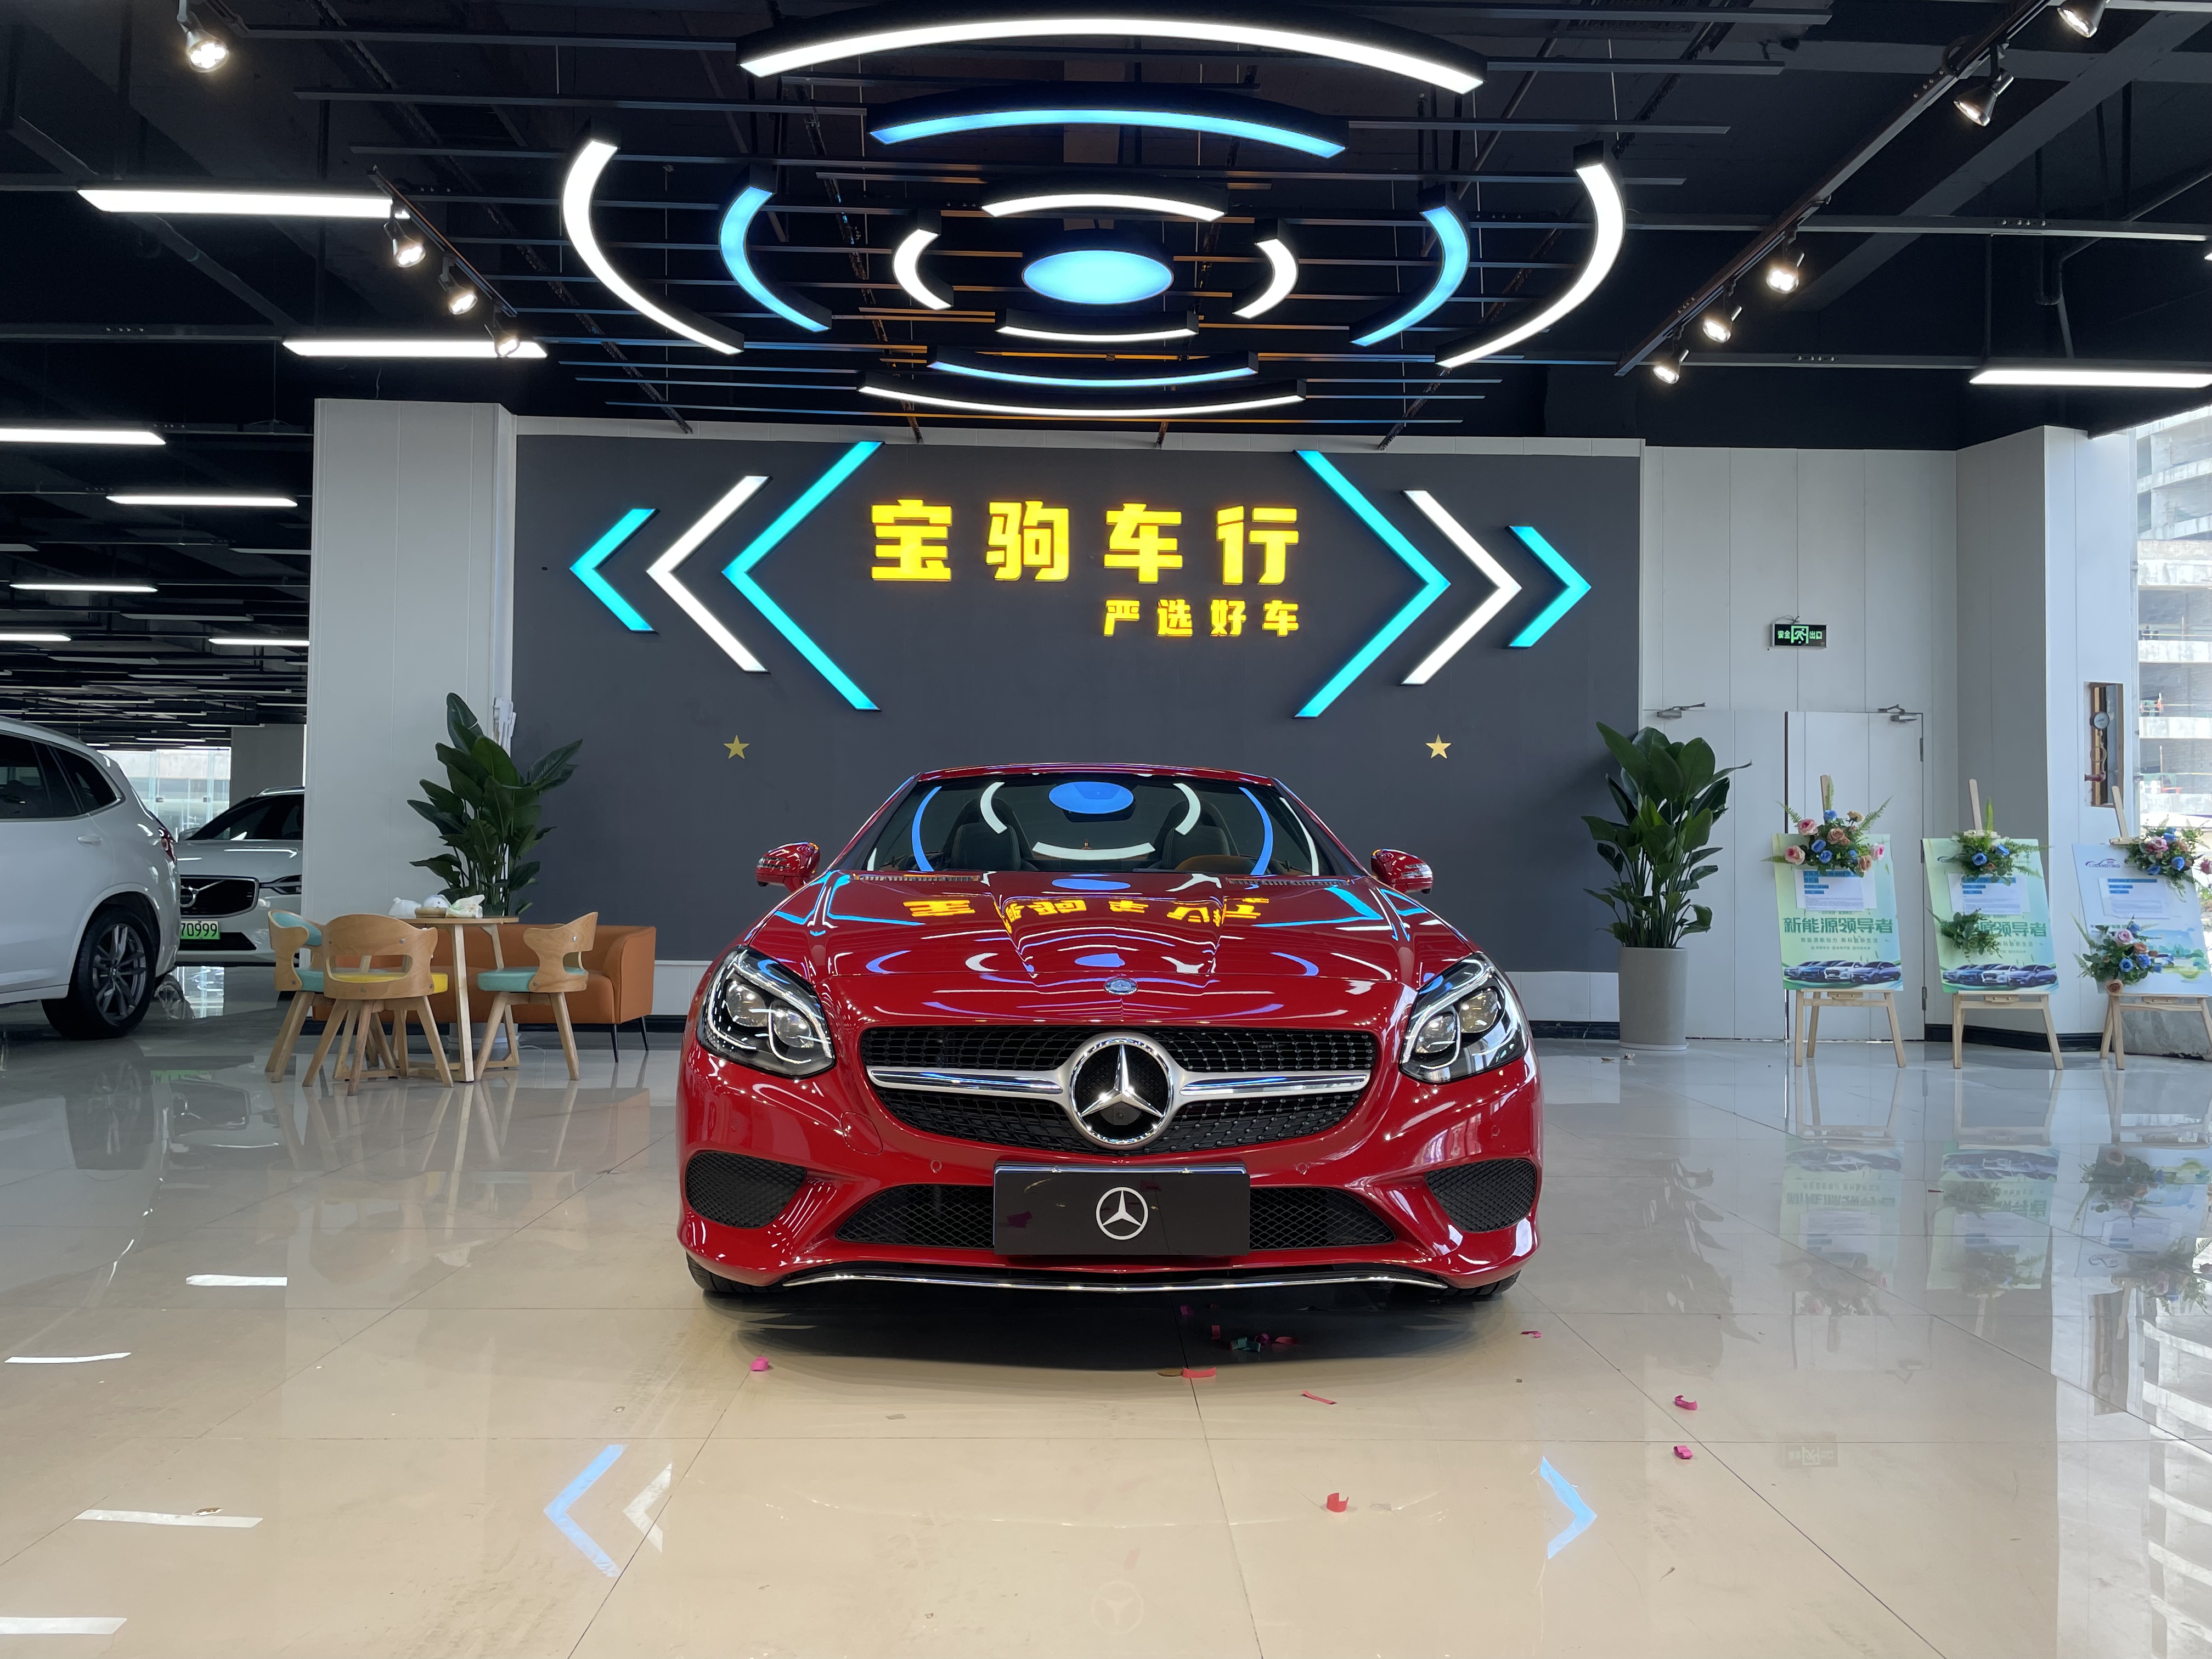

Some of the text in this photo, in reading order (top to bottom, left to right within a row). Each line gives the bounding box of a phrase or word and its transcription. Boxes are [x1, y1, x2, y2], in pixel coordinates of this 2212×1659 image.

[870, 499, 1300, 585] 宝驹车行
[1103, 599, 1300, 637] 严选好车
[1778, 630, 1822, 639] 安全 出口
[1783, 917, 1893, 934] 新能源领导者
